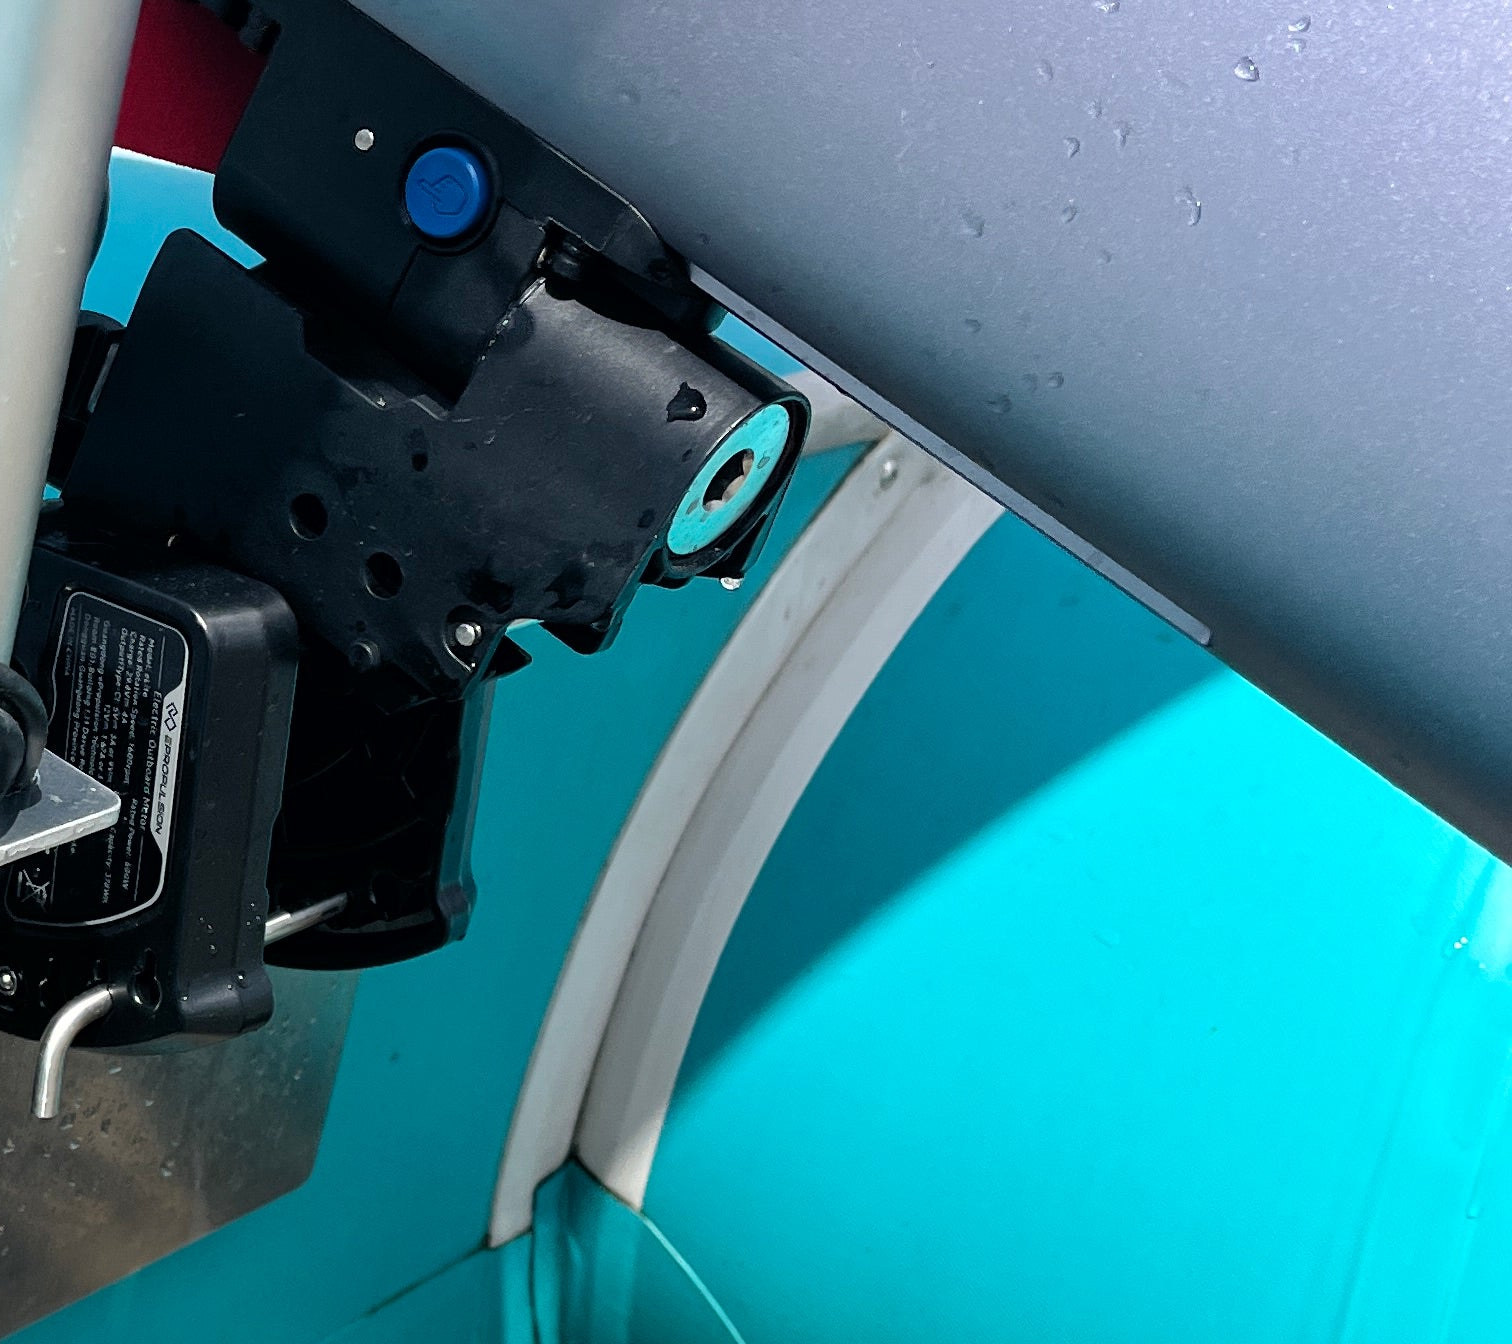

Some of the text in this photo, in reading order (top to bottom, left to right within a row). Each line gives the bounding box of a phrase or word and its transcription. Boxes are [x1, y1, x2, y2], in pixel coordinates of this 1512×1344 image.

[138, 690, 161, 831] Electric Outboard Motor
[154, 734, 172, 835] EPROPULSION
